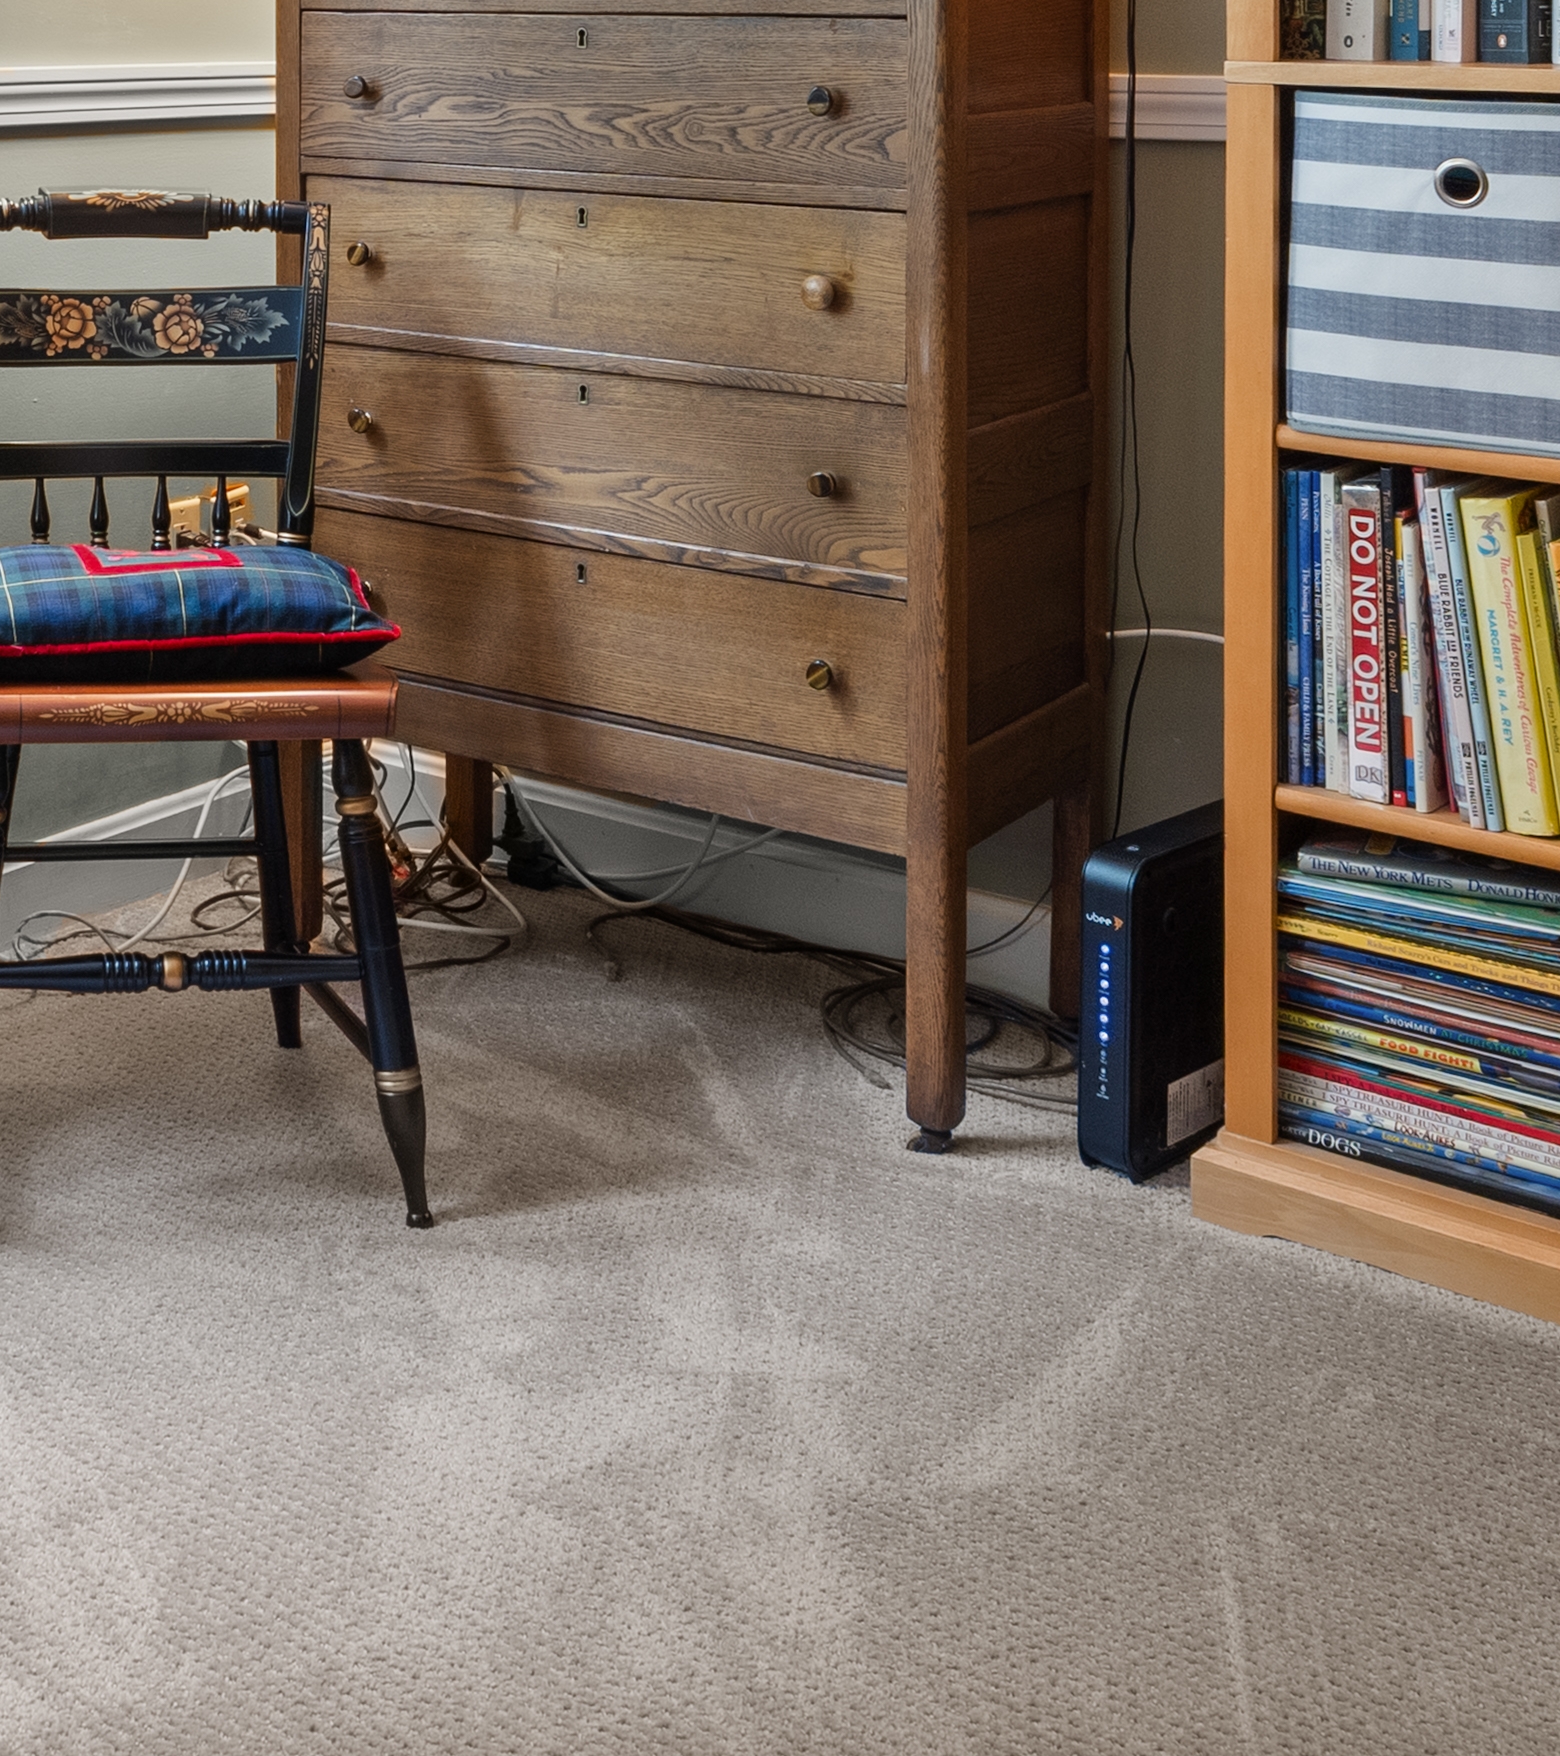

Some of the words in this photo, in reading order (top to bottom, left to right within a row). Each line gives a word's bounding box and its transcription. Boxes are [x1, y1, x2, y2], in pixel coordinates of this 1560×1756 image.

[1349, 515, 1376, 566] DO
[1385, 548, 1393, 580] Joseph
[1438, 573, 1450, 596] BLUE
[1350, 574, 1377, 646] NOT
[1442, 600, 1455, 637] RABBIT
[1388, 651, 1398, 693] Overcoat
[1449, 652, 1463, 699] FRIENDS
[1486, 608, 1503, 670] MARGRET
[1500, 715, 1513, 745] REY
[1353, 654, 1381, 751] OPEN
[1309, 855, 1336, 874] THE
[1337, 859, 1371, 878] NEW
[1372, 865, 1409, 885] YORK
[1410, 871, 1453, 890] METS
[1466, 878, 1524, 900] DONALD
[1086, 911, 1112, 926] ubee
[1382, 1013, 1438, 1036] SNOWMEN
[1378, 1037, 1420, 1058] FOOD
[1421, 1047, 1475, 1071] FIGHT!
[1352, 1100, 1412, 1124] TREASURE
[1506, 1144, 1541, 1162] Picture
[1354, 1089, 1414, 1116] TREASURE
[1510, 1131, 1544, 1152] Picture
[1393, 1121, 1456, 1148] LOOK-ALIKES
[1307, 1128, 1362, 1158] DOGS
